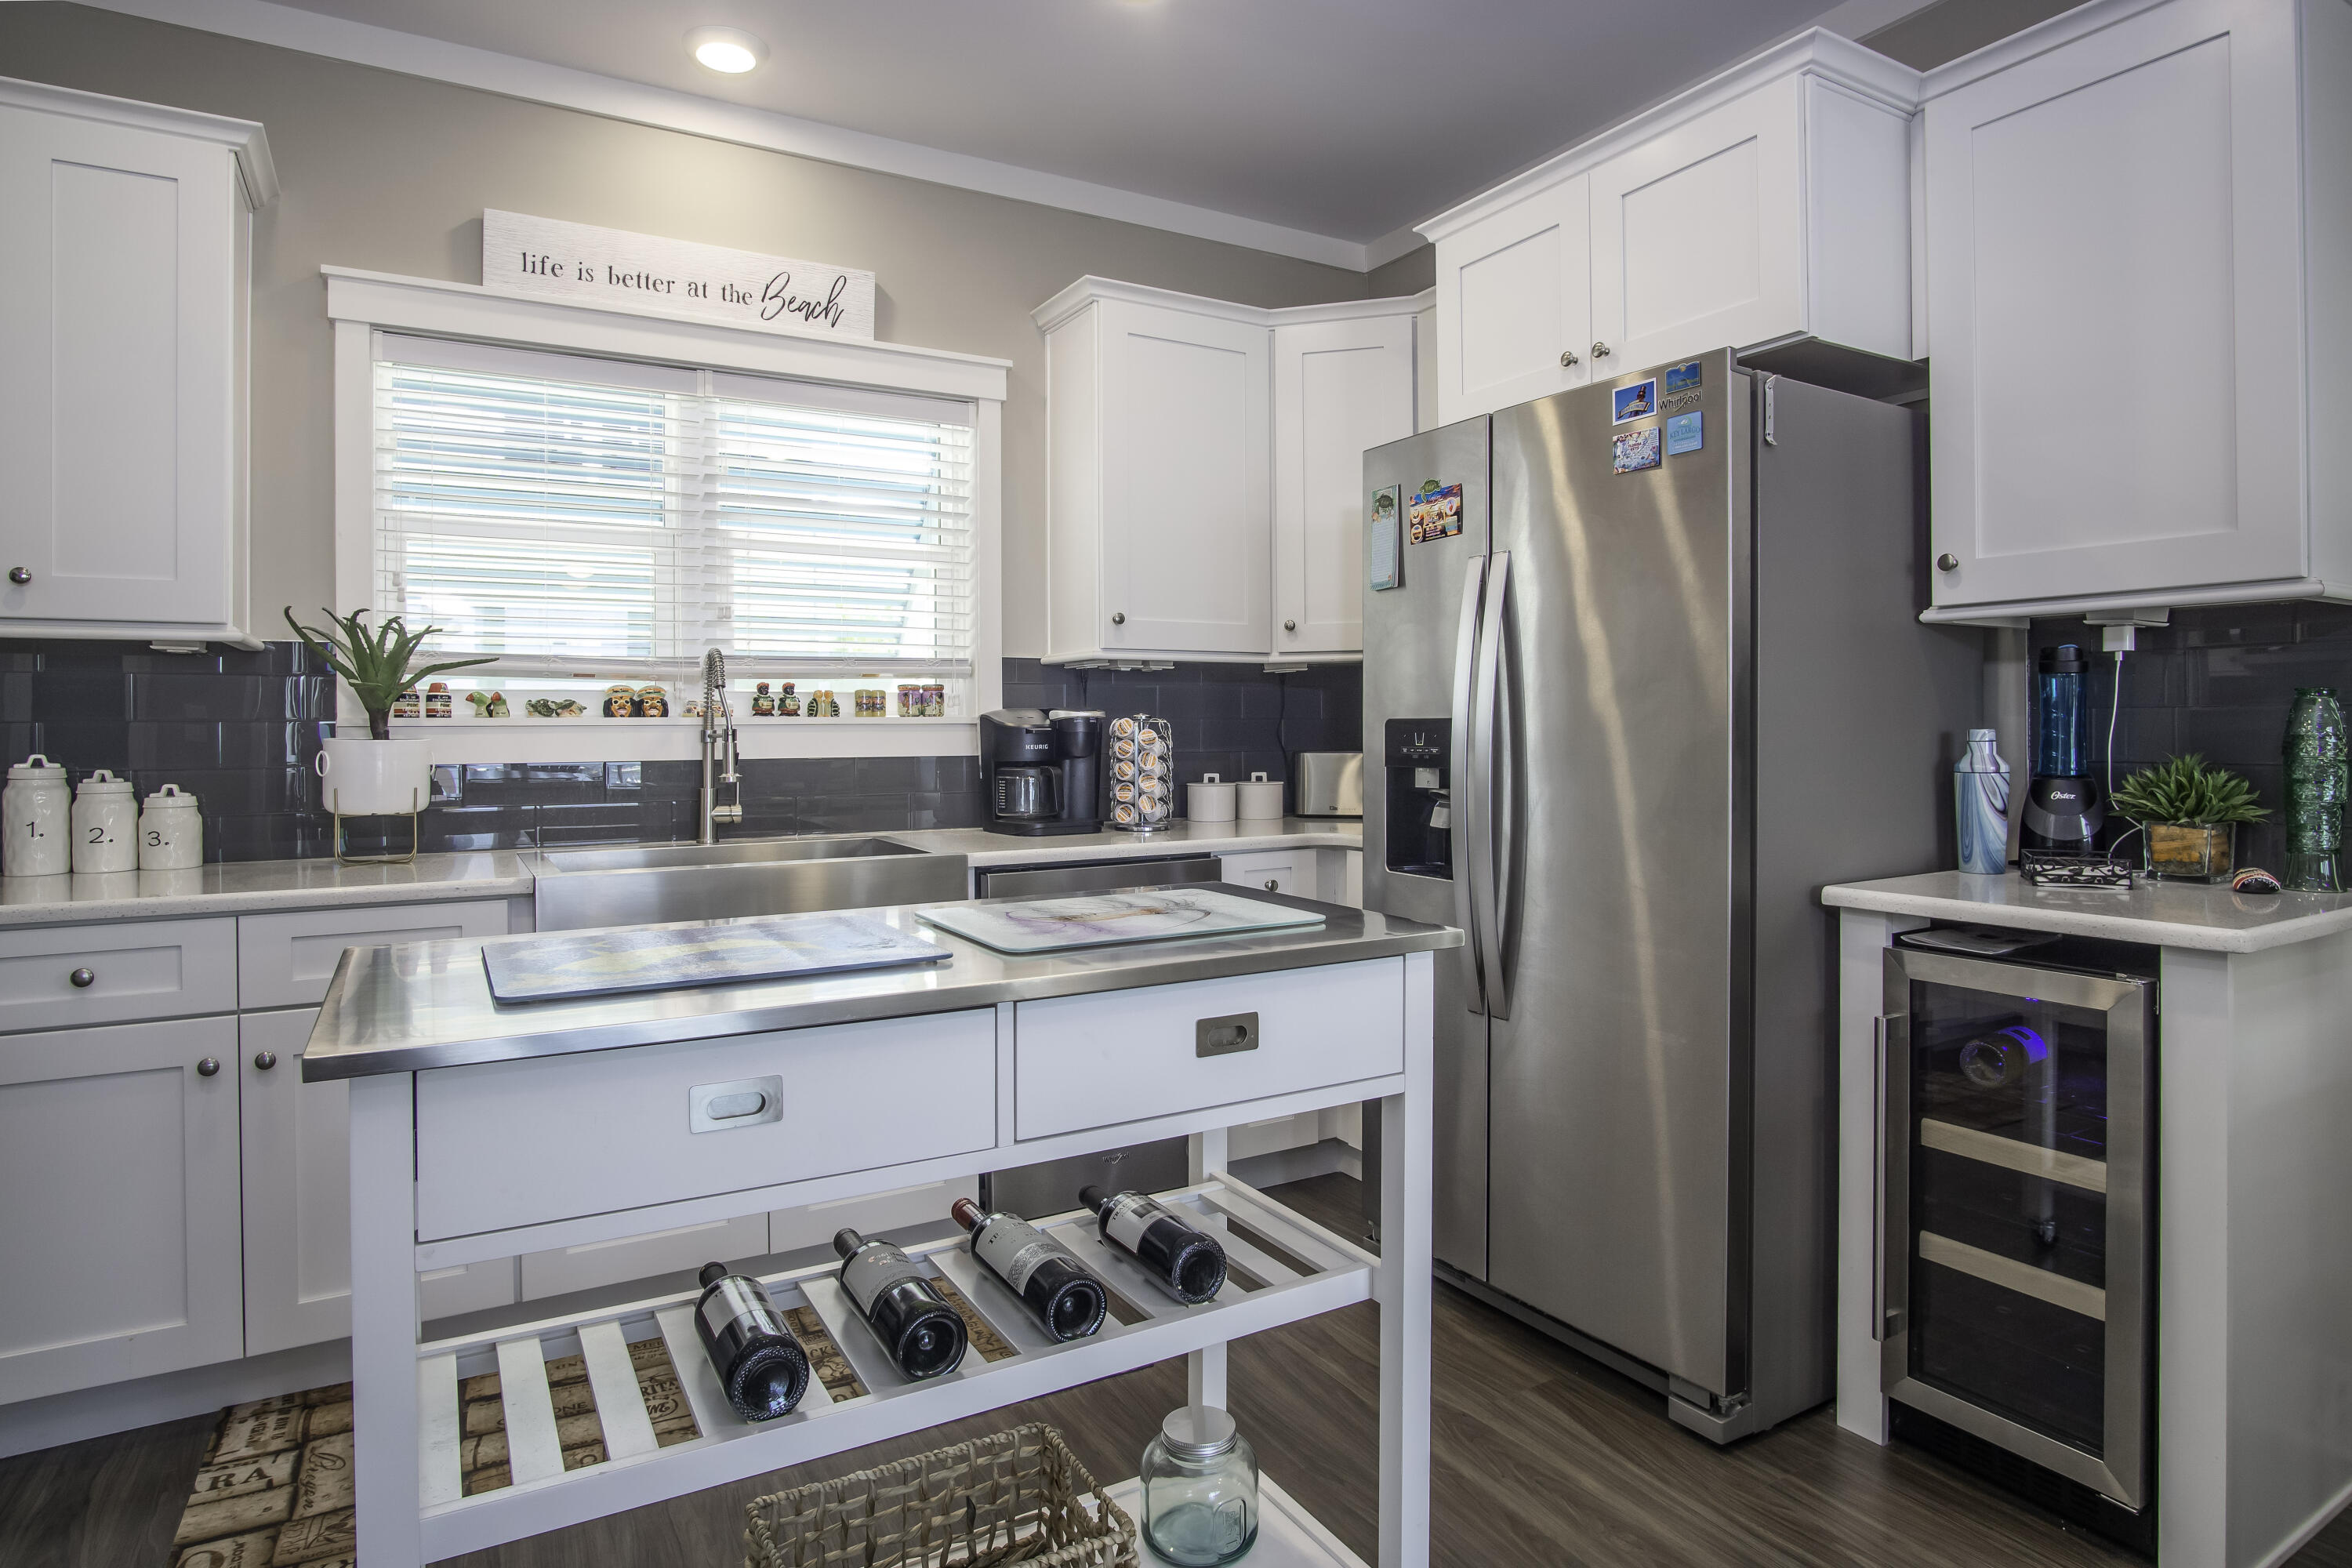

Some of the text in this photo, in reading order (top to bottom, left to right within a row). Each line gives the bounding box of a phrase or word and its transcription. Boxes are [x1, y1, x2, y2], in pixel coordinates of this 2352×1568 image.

[521, 251, 848, 328] life is better at the Beach
[1659, 390, 1702, 410] Whirlpool
[2051, 791, 2076, 800] Oster
[26, 821, 44, 838] 1.
[89, 827, 114, 844] 2.
[147, 831, 169, 848] 3.
